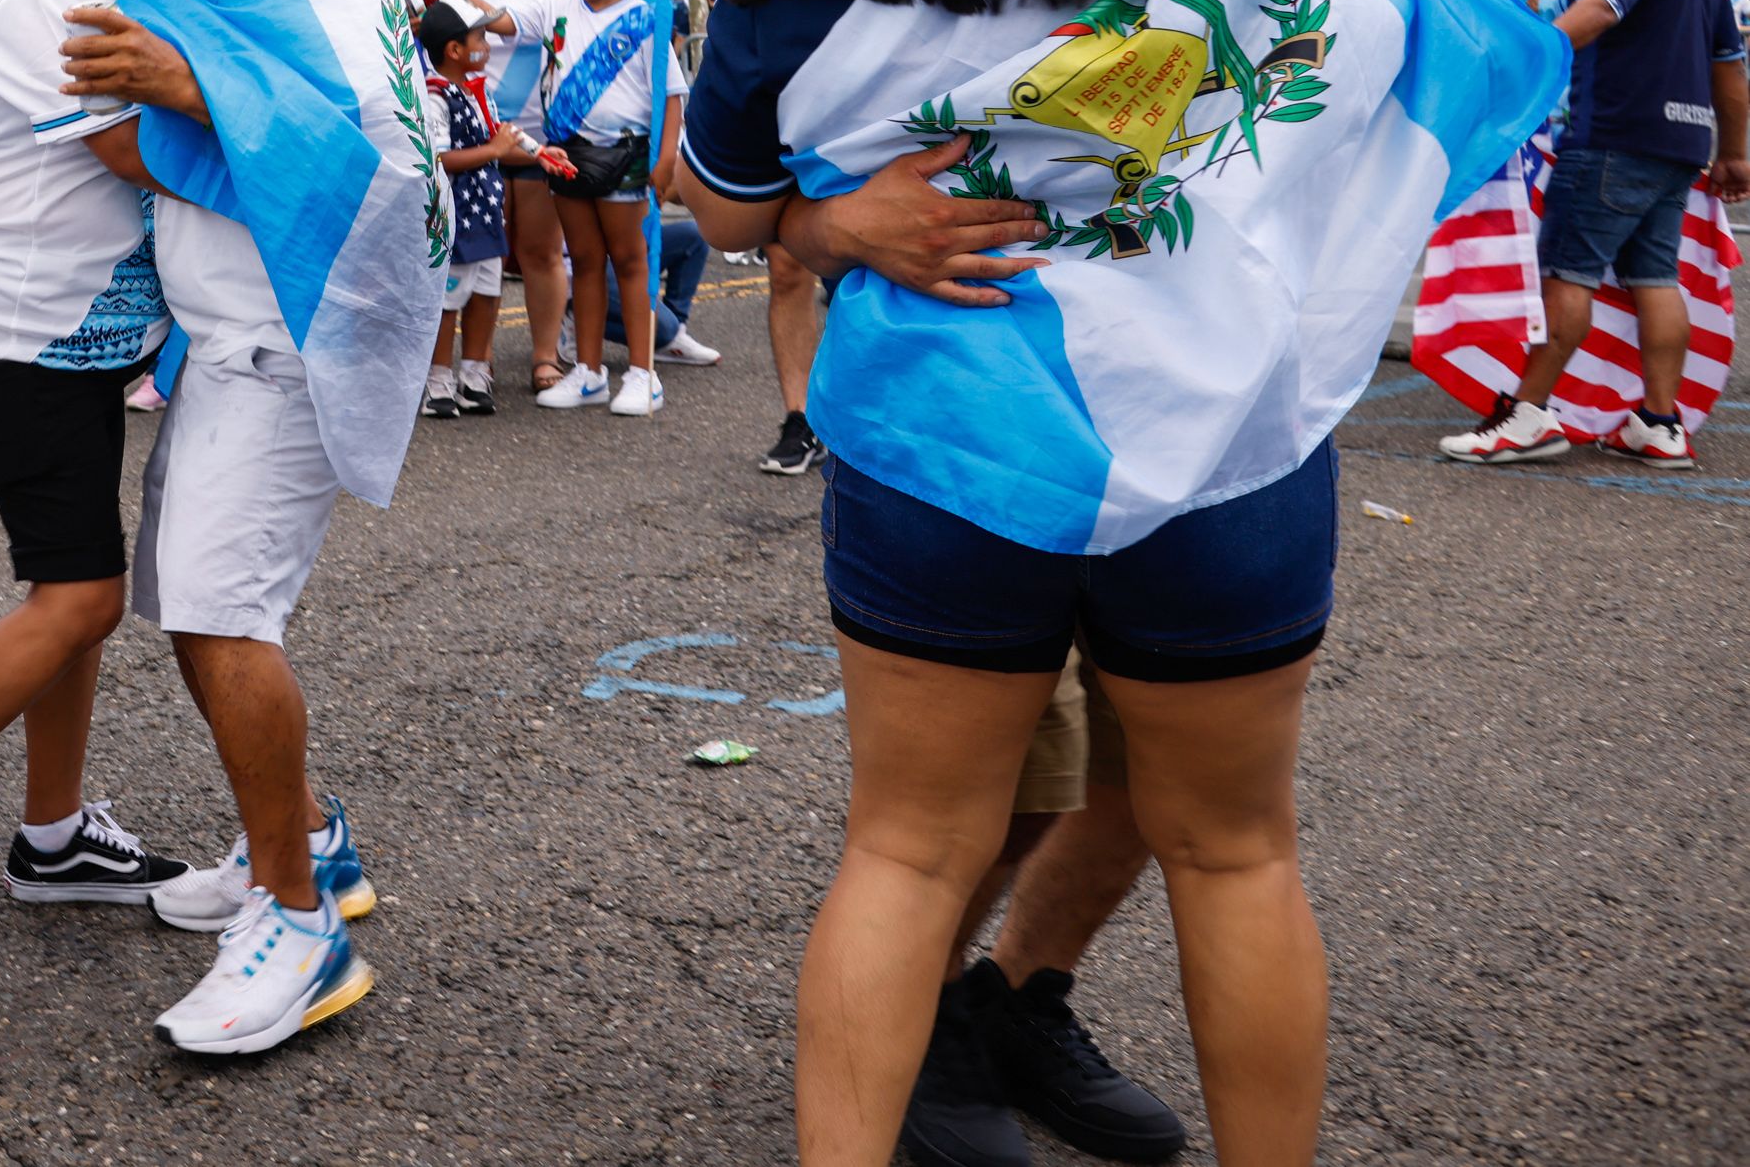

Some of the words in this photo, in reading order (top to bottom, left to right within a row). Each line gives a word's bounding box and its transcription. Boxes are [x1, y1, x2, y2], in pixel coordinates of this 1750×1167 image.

[1064, 50, 1139, 117] LIBERTAD
[1101, 90, 1122, 110] 15
[1122, 65, 1149, 89] DE
[1107, 43, 1185, 135] SEPTIEMBRE
[1142, 101, 1167, 128] DE
[1165, 59, 1193, 97] 1821
